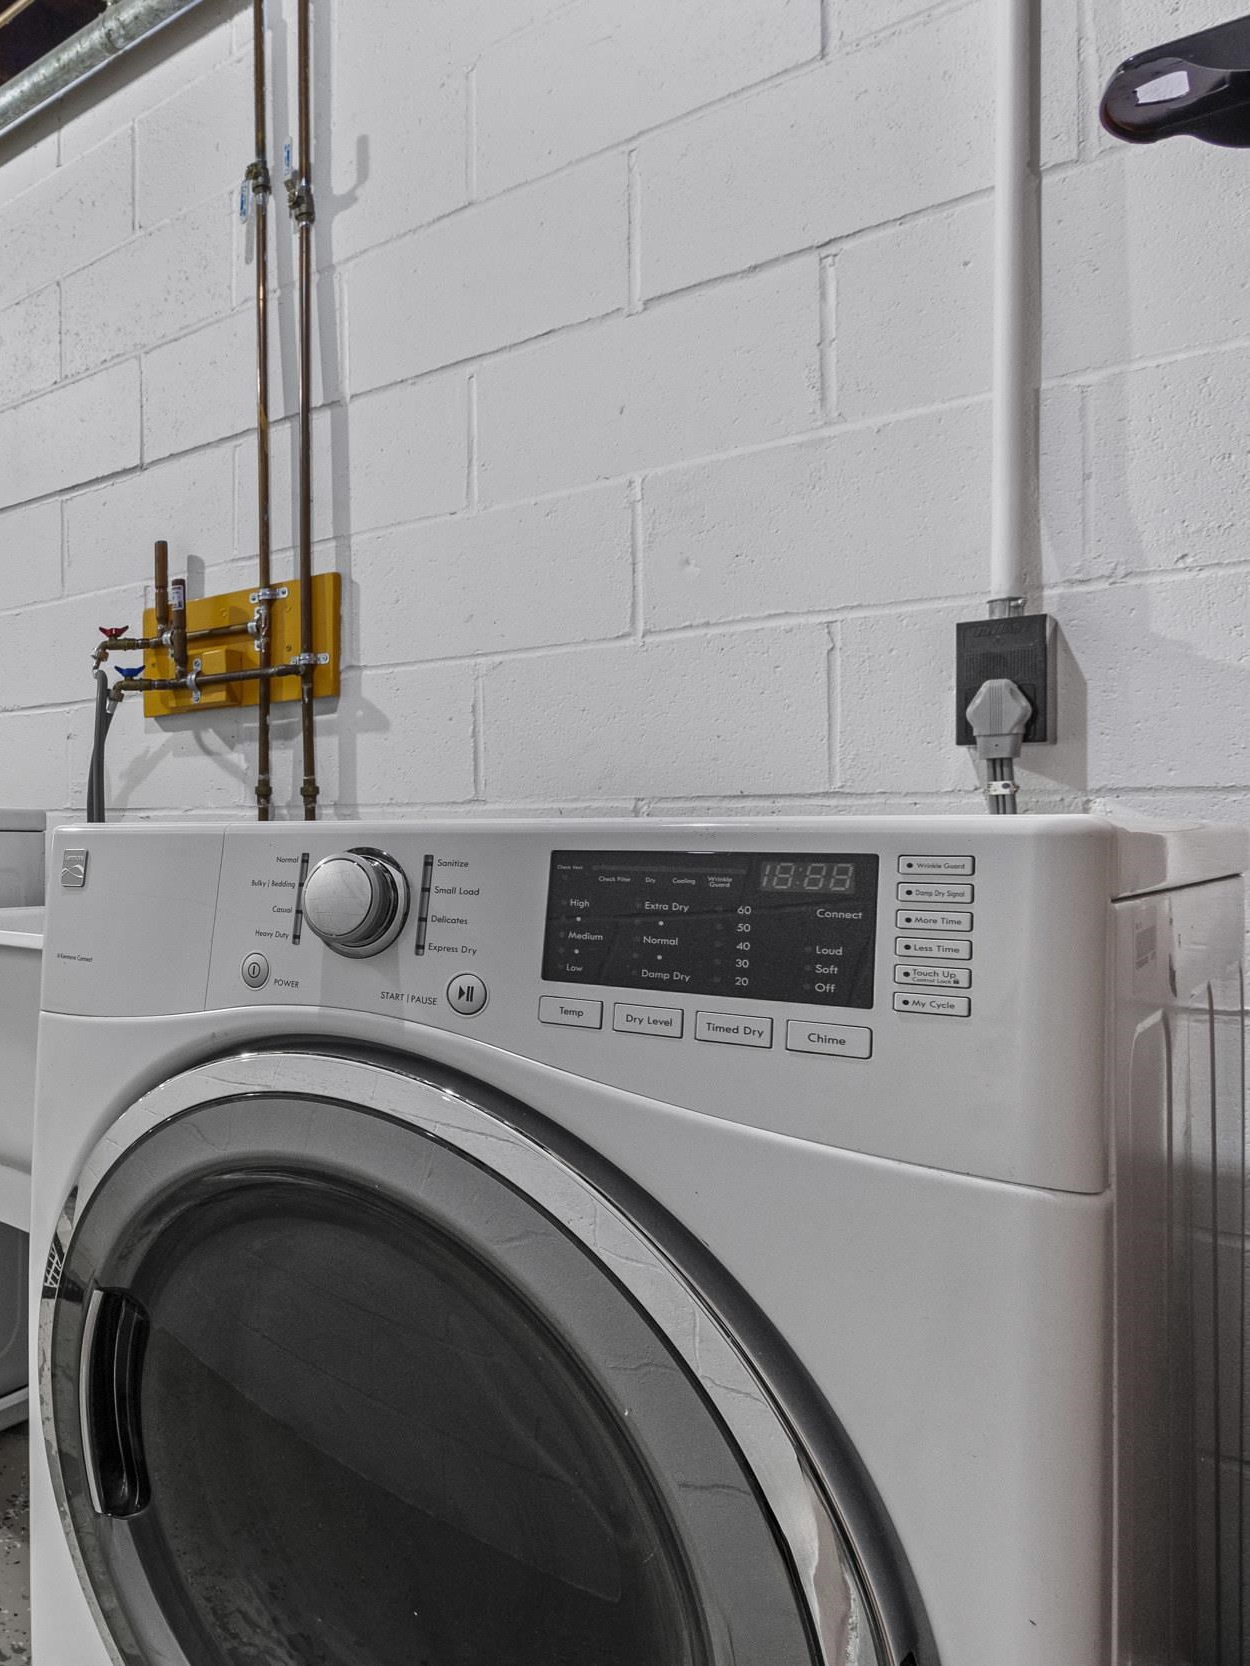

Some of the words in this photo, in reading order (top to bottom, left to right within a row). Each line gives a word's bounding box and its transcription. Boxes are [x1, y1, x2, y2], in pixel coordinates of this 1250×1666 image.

[276, 856, 299, 864] Normal
[437, 858, 469, 868] Sanitize
[251, 879, 266, 888] Bulky
[271, 879, 296, 890] Bedding
[645, 876, 656, 884] Dry
[434, 885, 457, 895] Small
[459, 887, 480, 896] Load
[934, 889, 945, 898] Dry
[569, 898, 590, 909] High
[644, 901, 669, 911] Extra
[672, 902, 690, 913] Dry
[272, 905, 293, 914] Casual
[737, 905, 752, 915] 60
[816, 908, 863, 919] Connect
[431, 914, 468, 925] Delicates
[940, 916, 962, 926] Time
[736, 923, 751, 933] 50
[255, 929, 274, 939] Heavy
[275, 930, 290, 940] Duty
[568, 931, 604, 941] Medium
[643, 935, 679, 946] Normal
[735, 941, 751, 951] 40
[429, 942, 459, 953] Express
[461, 945, 478, 956] Dry
[815, 944, 843, 956] Loud
[913, 944, 933, 952] Less
[936, 945, 960, 954] Time
[566, 963, 583, 973] Low
[735, 958, 750, 969] 30
[814, 964, 839, 974] Soft
[641, 969, 670, 981] Damp
[672, 971, 691, 983] Dry
[912, 968, 940, 977] Touch
[942, 970, 957, 980] Up
[273, 978, 299, 989] POWER
[734, 976, 749, 987] 20
[814, 982, 837, 993] Off
[380, 991, 405, 1001] START
[410, 994, 438, 1006] PAUSE
[911, 999, 926, 1008] My
[929, 1000, 956, 1010] Cycle
[559, 1006, 584, 1018] Temp
[625, 1013, 644, 1026] Dry
[646, 1016, 673, 1028] Level
[706, 1022, 740, 1035] Timed
[743, 1026, 765, 1039] Dry
[807, 1032, 847, 1047] Chime
